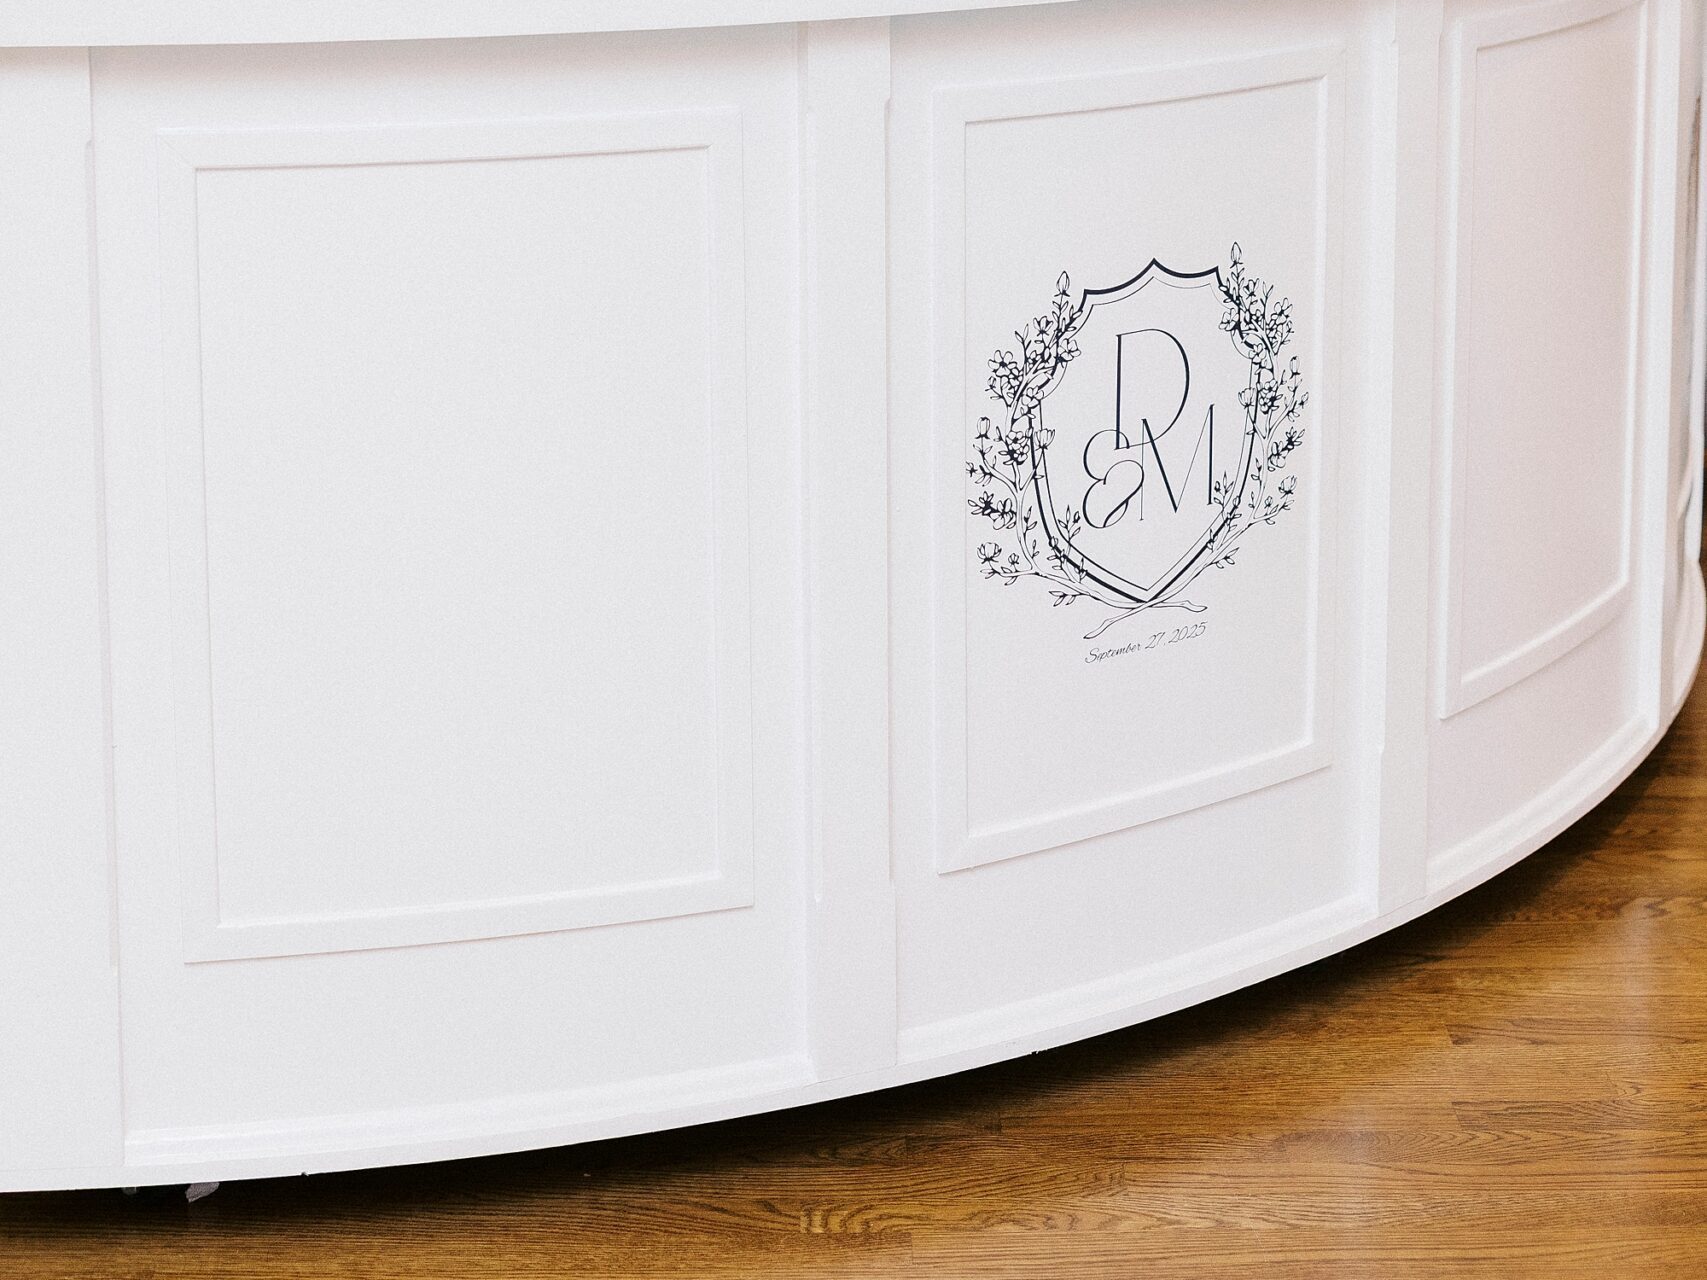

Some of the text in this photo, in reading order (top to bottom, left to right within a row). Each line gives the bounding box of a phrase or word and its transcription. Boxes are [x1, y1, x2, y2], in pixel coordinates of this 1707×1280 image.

[1114, 328, 1190, 450] D
[1083, 428, 1145, 529] &
[1084, 642, 1141, 664] September
[1167, 621, 1208, 643] 2025
